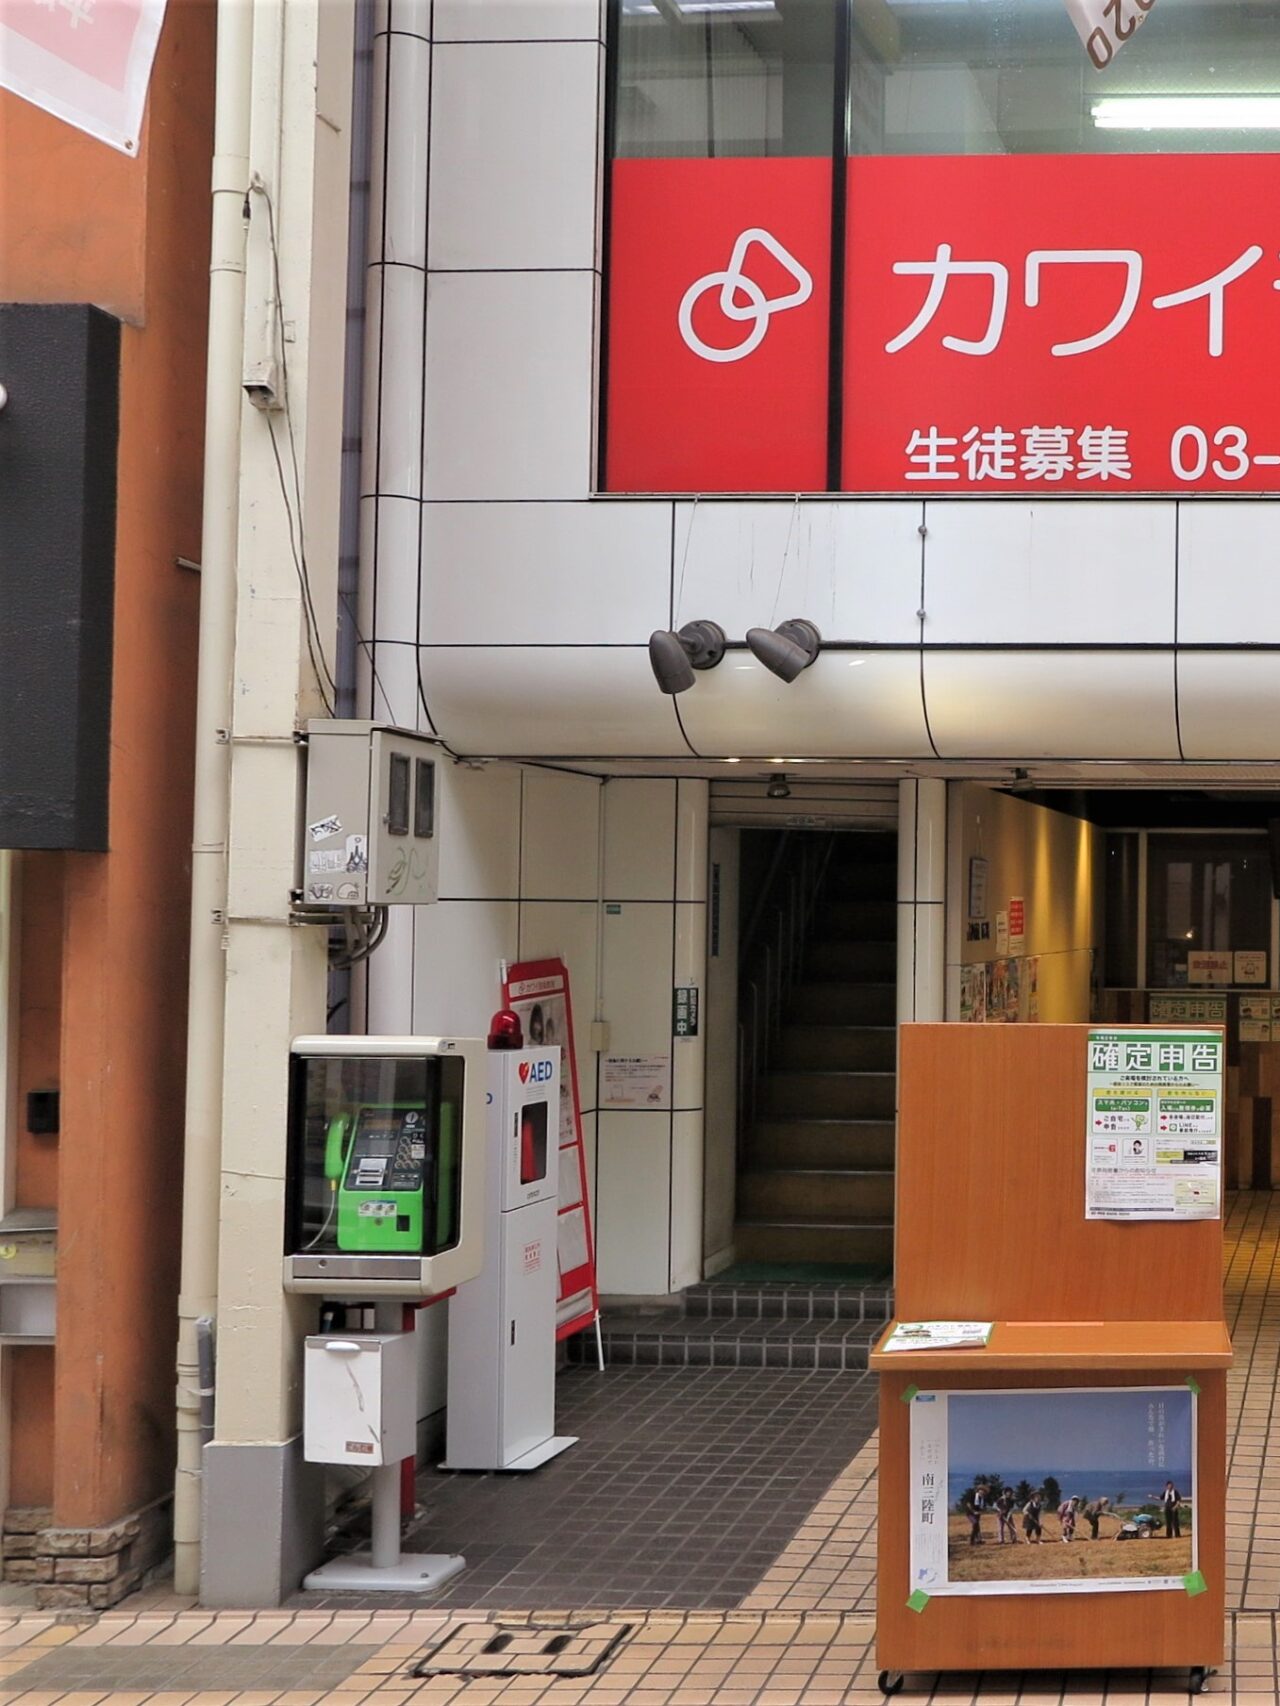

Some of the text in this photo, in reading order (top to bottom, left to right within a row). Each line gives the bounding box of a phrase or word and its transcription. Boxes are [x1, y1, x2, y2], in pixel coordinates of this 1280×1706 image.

[905, 426, 1132, 481] 生徒募集
[529, 1060, 553, 1083] AED
[1093, 1043, 1218, 1072] 確定申告
[921, 1472, 935, 1525] 南三陸町
